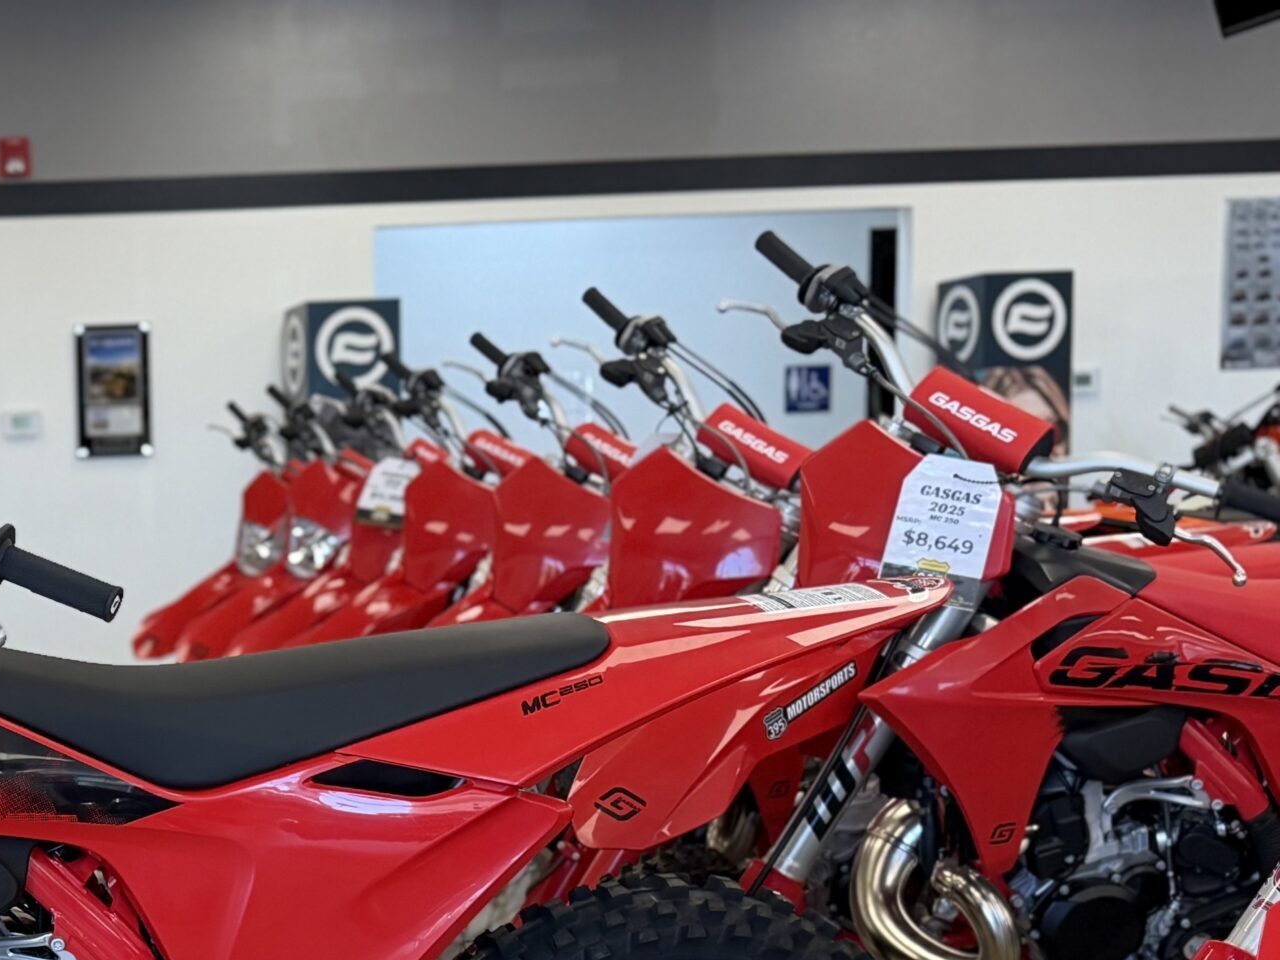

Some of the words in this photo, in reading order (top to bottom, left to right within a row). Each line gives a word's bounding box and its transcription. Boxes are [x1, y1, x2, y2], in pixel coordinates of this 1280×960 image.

[928, 391, 1018, 443] GASGAS
[718, 420, 789, 464] GASGAS
[920, 485, 983, 505] GASGAS
[928, 502, 966, 517] 2025
[929, 514, 943, 523] MC
[944, 516, 960, 526] 250
[902, 528, 974, 555] $8,649
[786, 661, 856, 721] MOTORSPORTS
[768, 719, 786, 739] 395
